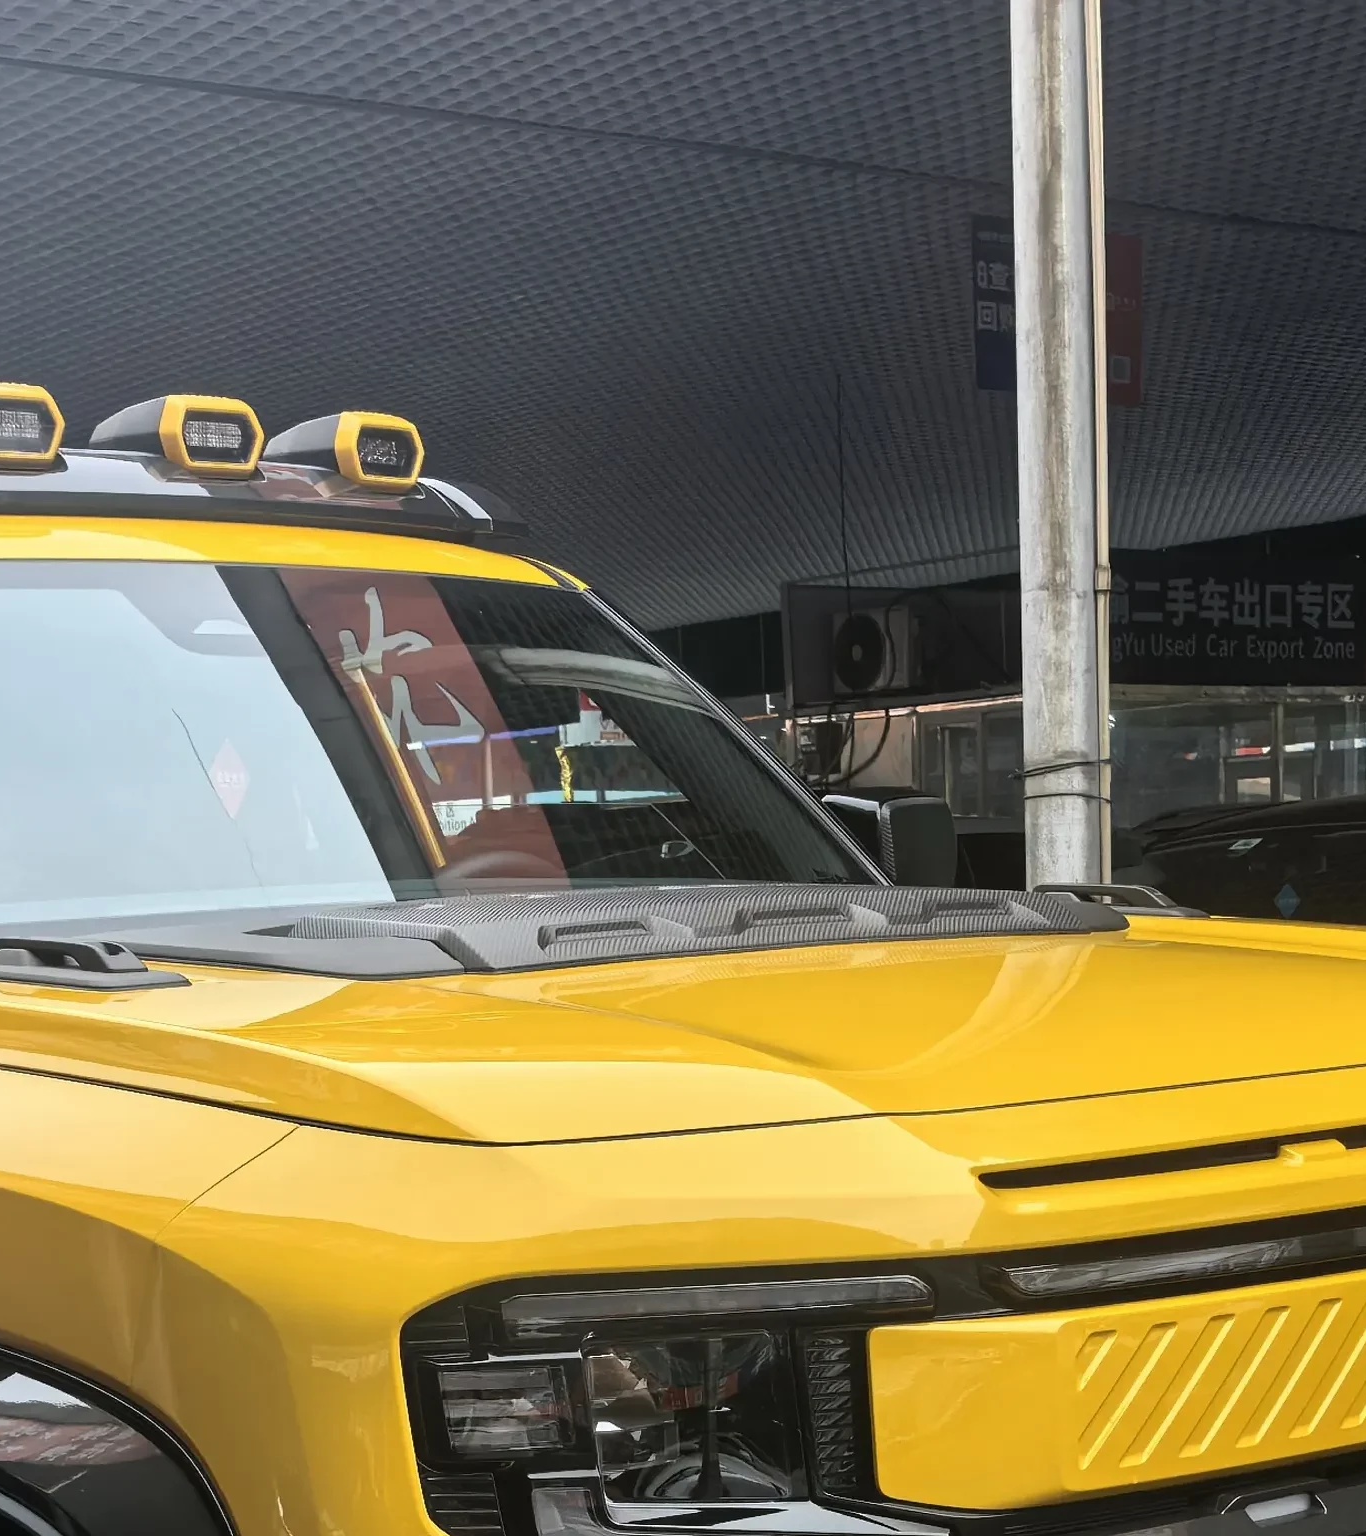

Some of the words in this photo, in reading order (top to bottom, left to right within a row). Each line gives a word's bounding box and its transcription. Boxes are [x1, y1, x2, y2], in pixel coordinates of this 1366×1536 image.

[1112, 632, 1146, 662] gYu
[1150, 632, 1196, 658] Used
[1206, 634, 1235, 658] Car
[1246, 633, 1305, 663] Export
[1313, 635, 1356, 660] Zone
